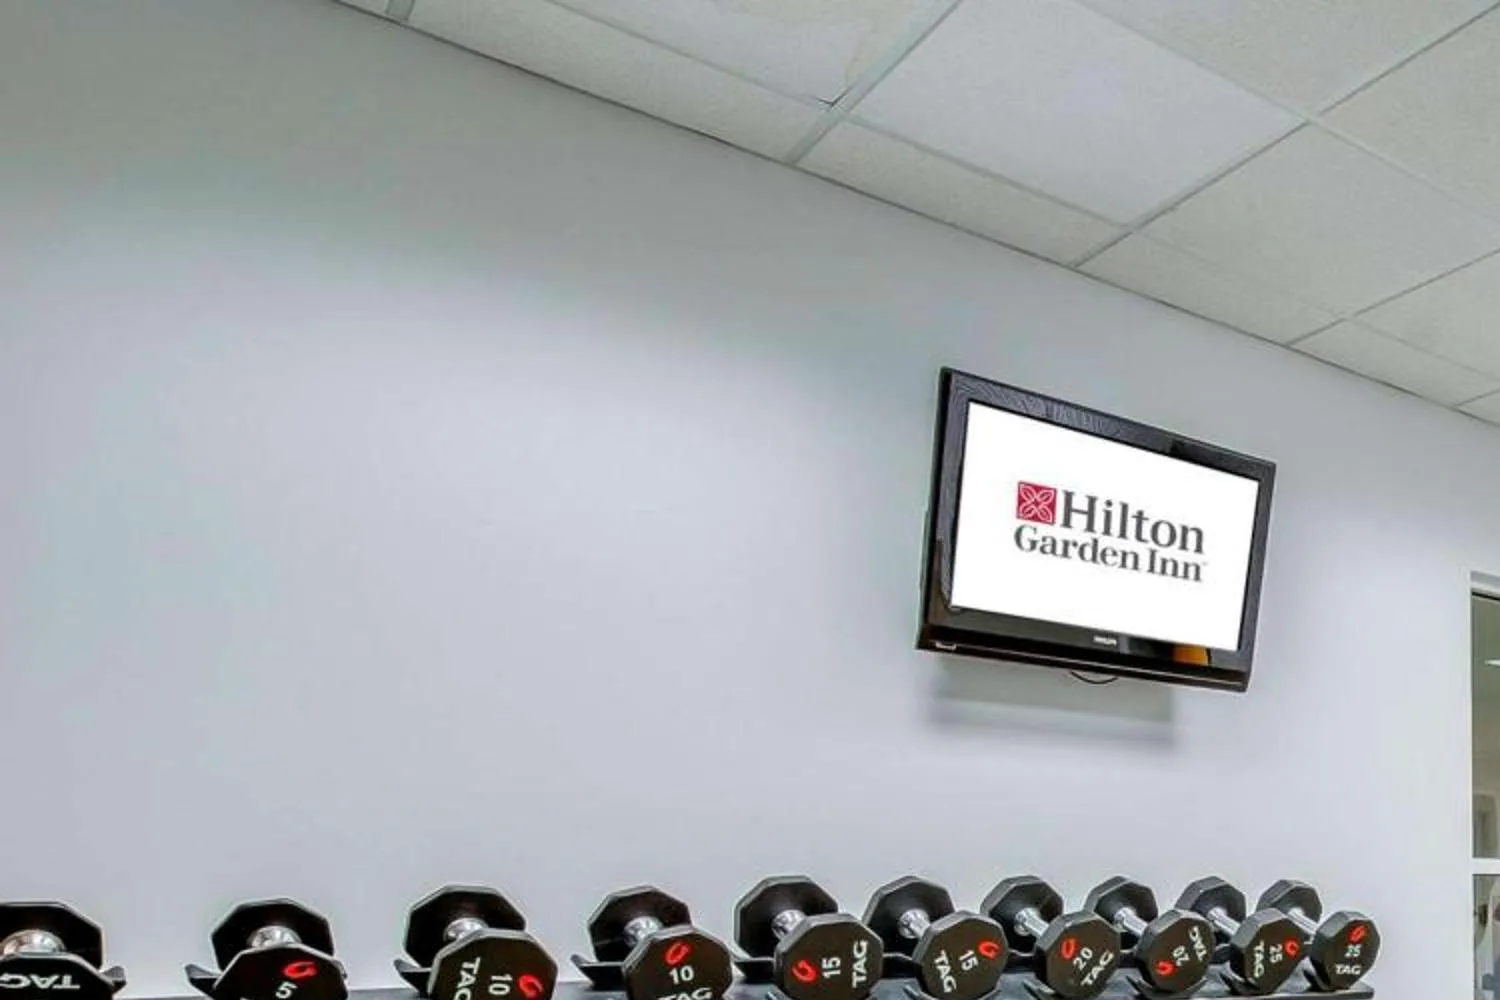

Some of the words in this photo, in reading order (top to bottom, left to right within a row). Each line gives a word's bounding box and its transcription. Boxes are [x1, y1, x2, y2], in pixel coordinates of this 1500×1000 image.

[1061, 489, 1205, 556] Hilton
[1013, 523, 1141, 572] Garden
[1146, 548, 1204, 583] Inn
[1189, 925, 1207, 961] TAG
[1269, 943, 1283, 964] 25
[1344, 943, 1362, 958] 25
[821, 956, 841, 979] 15
[851, 939, 869, 988] TAG
[959, 950, 979, 971] 15
[1072, 947, 1093, 971] 20
[1080, 947, 1115, 985] TAG
[1172, 945, 1190, 967] 20
[1253, 941, 1265, 978] TAG
[0, 972, 81, 990] TAG
[669, 965, 694, 985] 10
[934, 949, 957, 993] TAG
[1335, 963, 1361, 976] TAG
[275, 981, 297, 999] 5
[488, 973, 513, 996] 10
